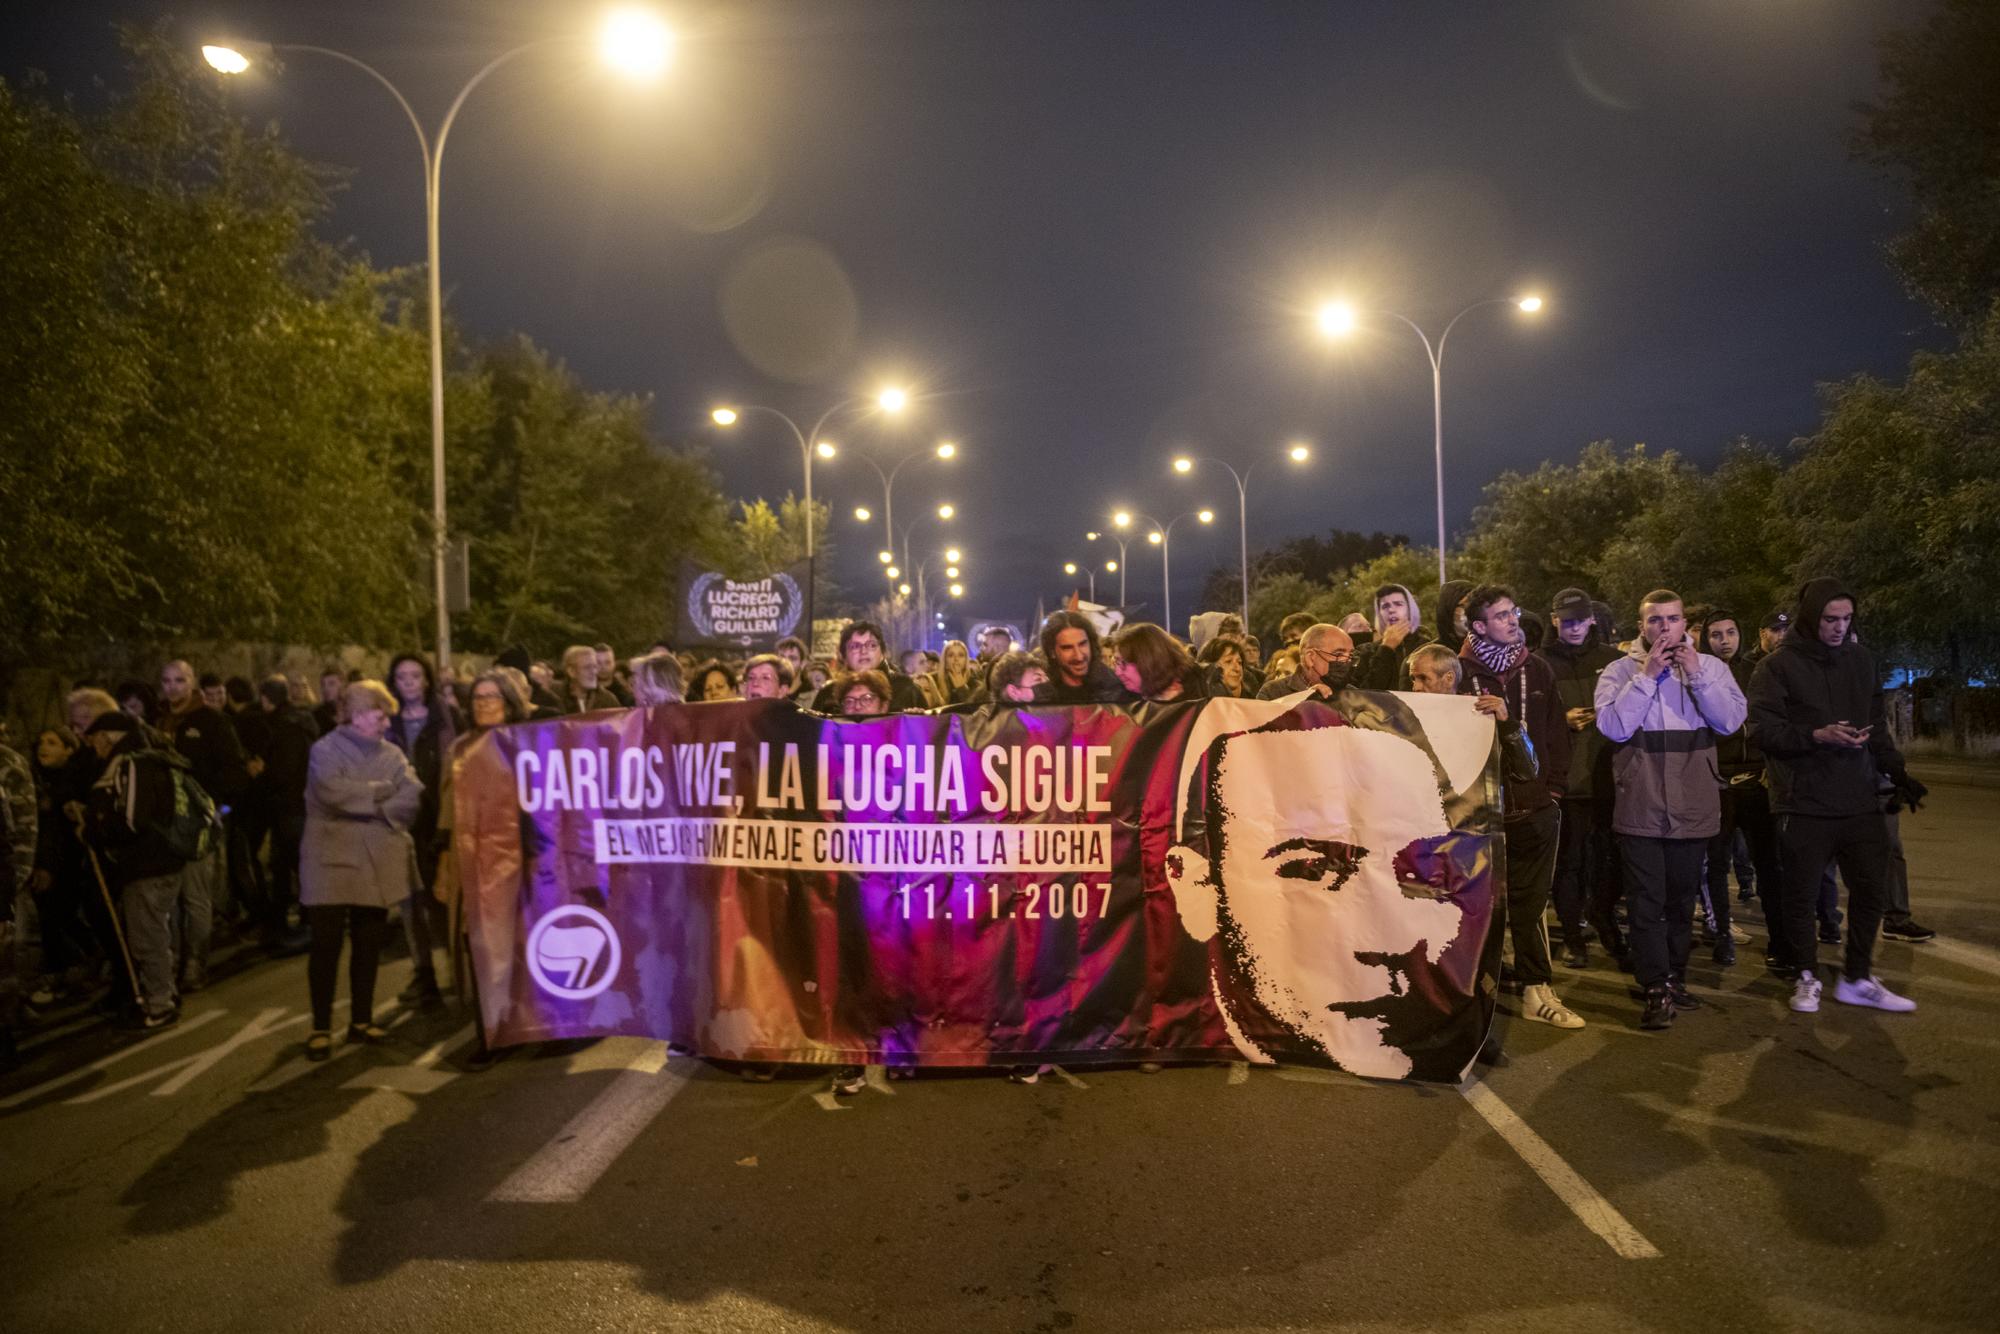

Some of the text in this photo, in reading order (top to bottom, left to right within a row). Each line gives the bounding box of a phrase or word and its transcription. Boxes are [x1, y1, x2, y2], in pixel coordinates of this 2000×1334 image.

[708, 590, 783, 605] LUCRECIA
[711, 604, 780, 619] RICHARD
[714, 619, 778, 633] GUILLEM
[515, 745, 665, 813] CARLOS
[757, 742, 805, 810] LA
[817, 744, 968, 812] LUCHA
[981, 745, 1112, 813] SIGUE
[606, 824, 632, 856] EL
[814, 828, 965, 864] CONTINUAR
[976, 830, 1008, 865] LA
[1019, 830, 1105, 866] LUCHA
[901, 883, 1113, 920] 11.11.2007
